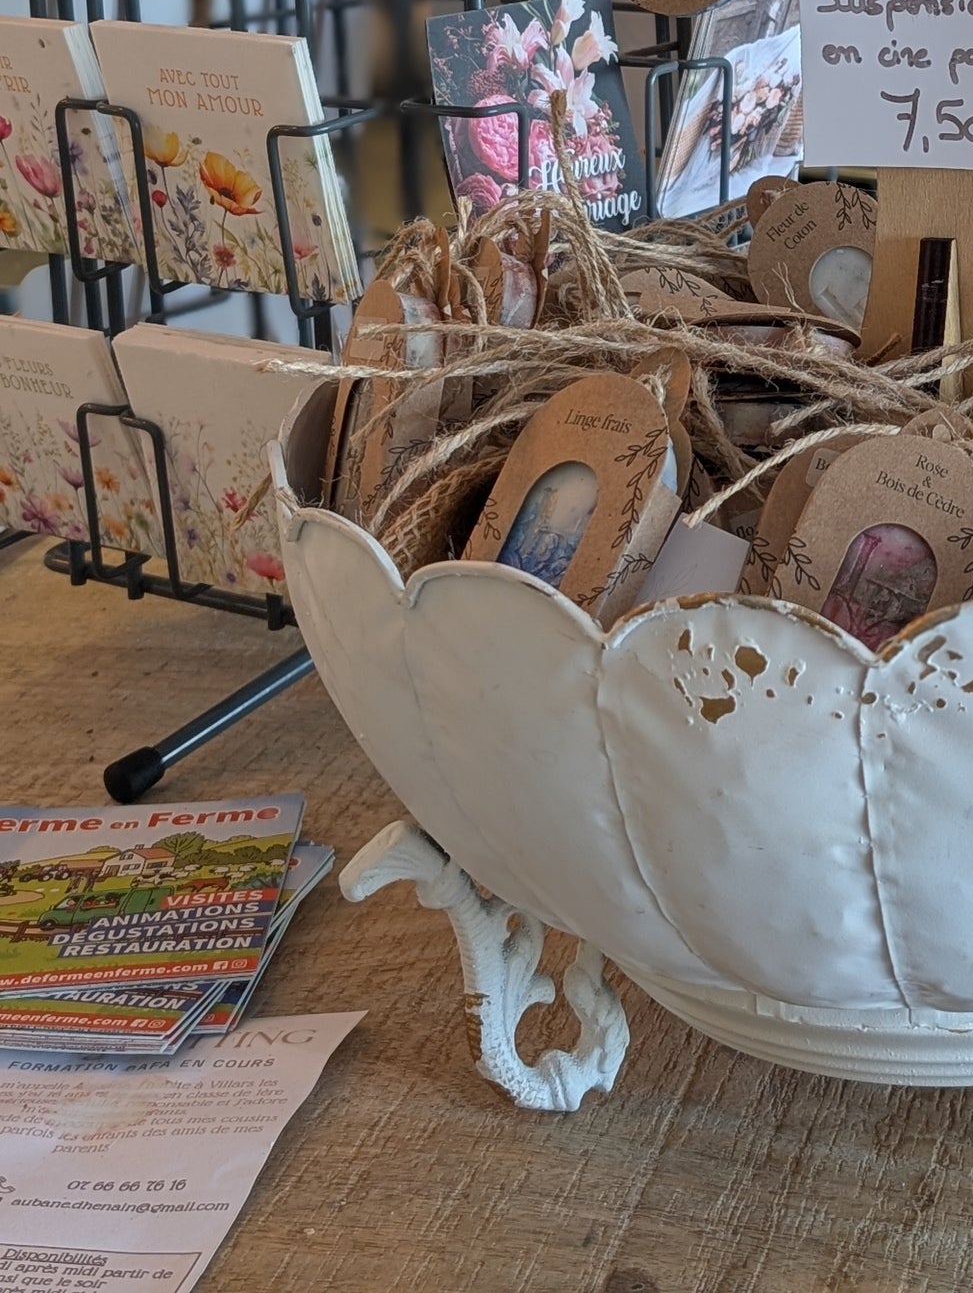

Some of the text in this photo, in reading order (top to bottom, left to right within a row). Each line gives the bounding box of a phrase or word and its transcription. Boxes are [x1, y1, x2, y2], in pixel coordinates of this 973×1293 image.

[822, 43, 863, 65] en
[160, 68, 239, 91] AVEC TOUT
[146, 88, 264, 117] MON AMOUR
[765, 199, 811, 243] Fleur de
[783, 219, 818, 251] Coton
[3, 356, 54, 377] FLEURS
[564, 409, 633, 434] Linge frais
[915, 453, 949, 479] Rose
[921, 476, 933, 488] &
[875, 470, 965, 519] Bois de Cèdre
[110, 820, 139, 830] en
[148, 806, 281, 829] Ferme
[166, 889, 263, 907] VISITES
[92, 901, 260, 928] ANIMATIONS
[51, 917, 256, 946] DÉGUSTATIONS
[62, 936, 252, 957] RESTAURATION
[8, 1060, 118, 1073] FORMATION
[180, 1059, 206, 1068] EN
[213, 1058, 276, 1068] COURS
[211, 1079, 255, 1089] Villars
[232, 1088, 252, 1097] de
[210, 1124, 231, 1135] de
[233, 1124, 265, 1134] mes
[221, 1114, 279, 1124] cousins
[52, 1143, 111, 1155] parents
[93, 1180, 115, 1191] 66
[119, 1180, 141, 1191] 66
[169, 1179, 188, 1191] 16
[3, 1248, 108, 1266] Disponibilités
[14, 1263, 58, 1274] après
[62, 1265, 100, 1277] midi
[101, 1269, 150, 1280] partir
[152, 1269, 173, 1280] de
[21, 1276, 54, 1287] que
[56, 1276, 72, 1287] le
[74, 1278, 108, 1289] soir
